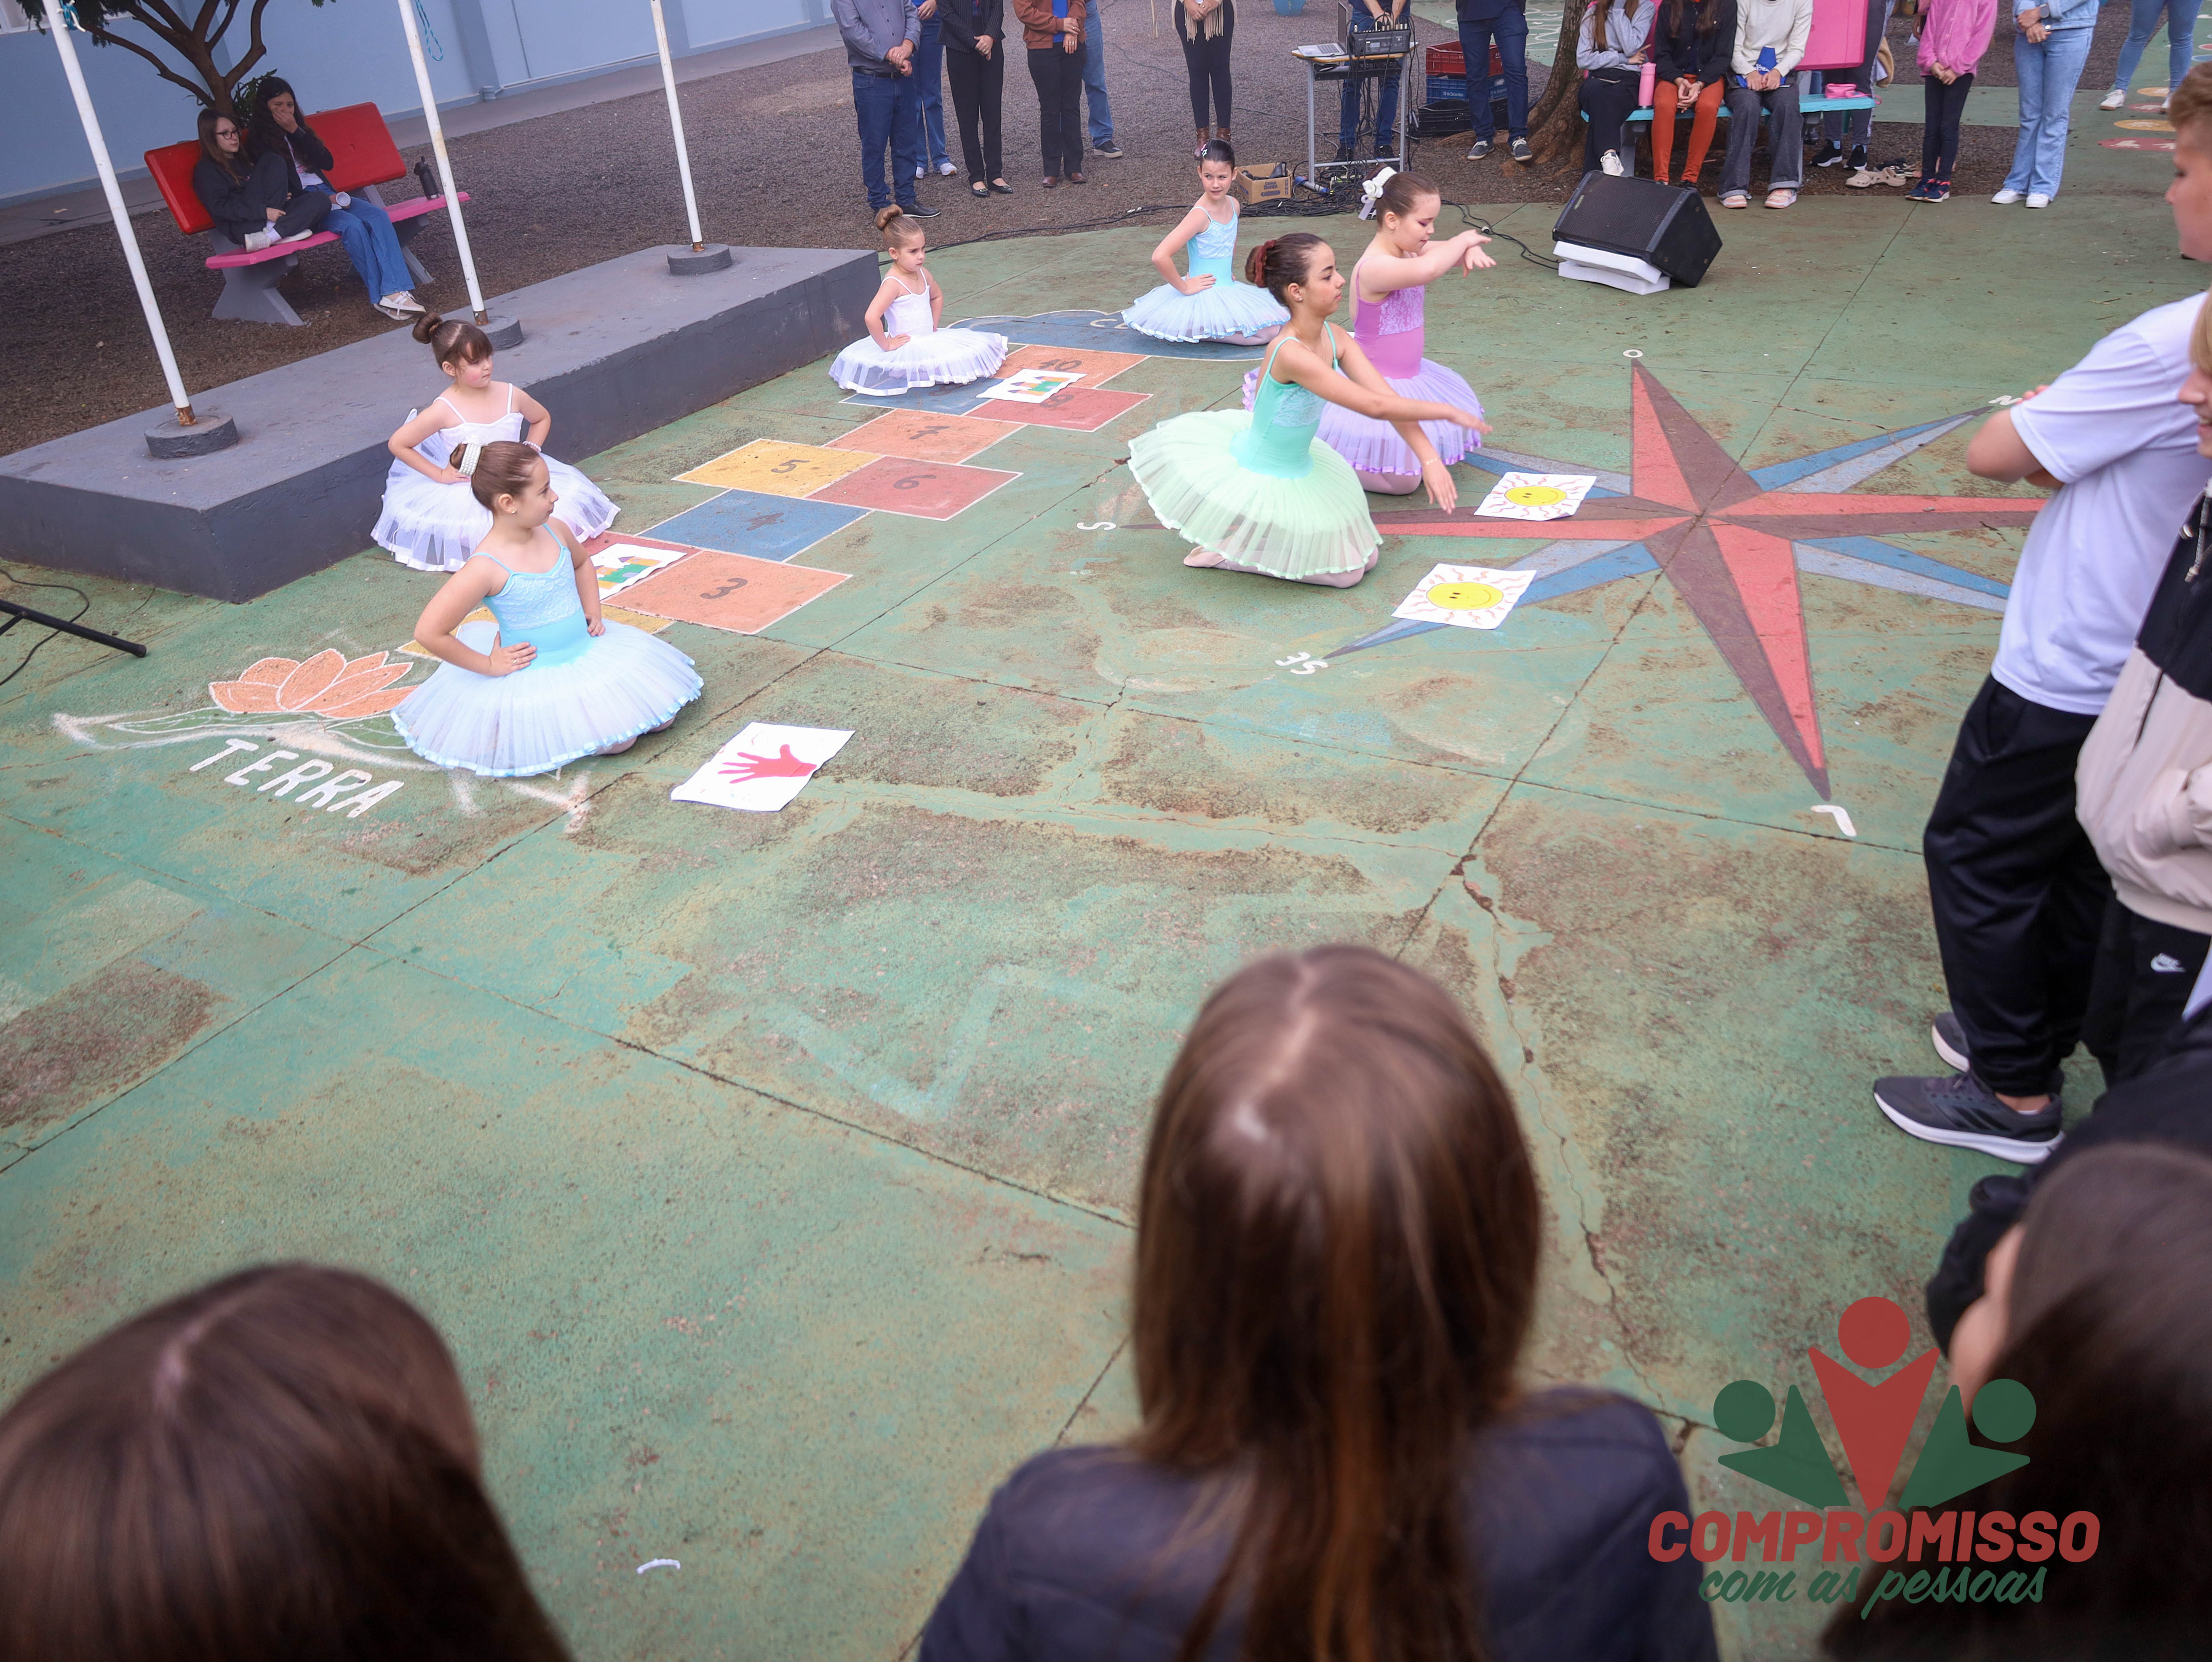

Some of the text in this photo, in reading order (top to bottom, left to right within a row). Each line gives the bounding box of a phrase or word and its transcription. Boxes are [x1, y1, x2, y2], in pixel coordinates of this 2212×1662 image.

[1039, 359, 1082, 371] 10
[909, 426, 951, 439] 7
[771, 459, 810, 473] 5
[893, 475, 937, 489] 6
[745, 512, 784, 531] 4
[700, 578, 748, 599] 3
[189, 738, 404, 818] TERRA
